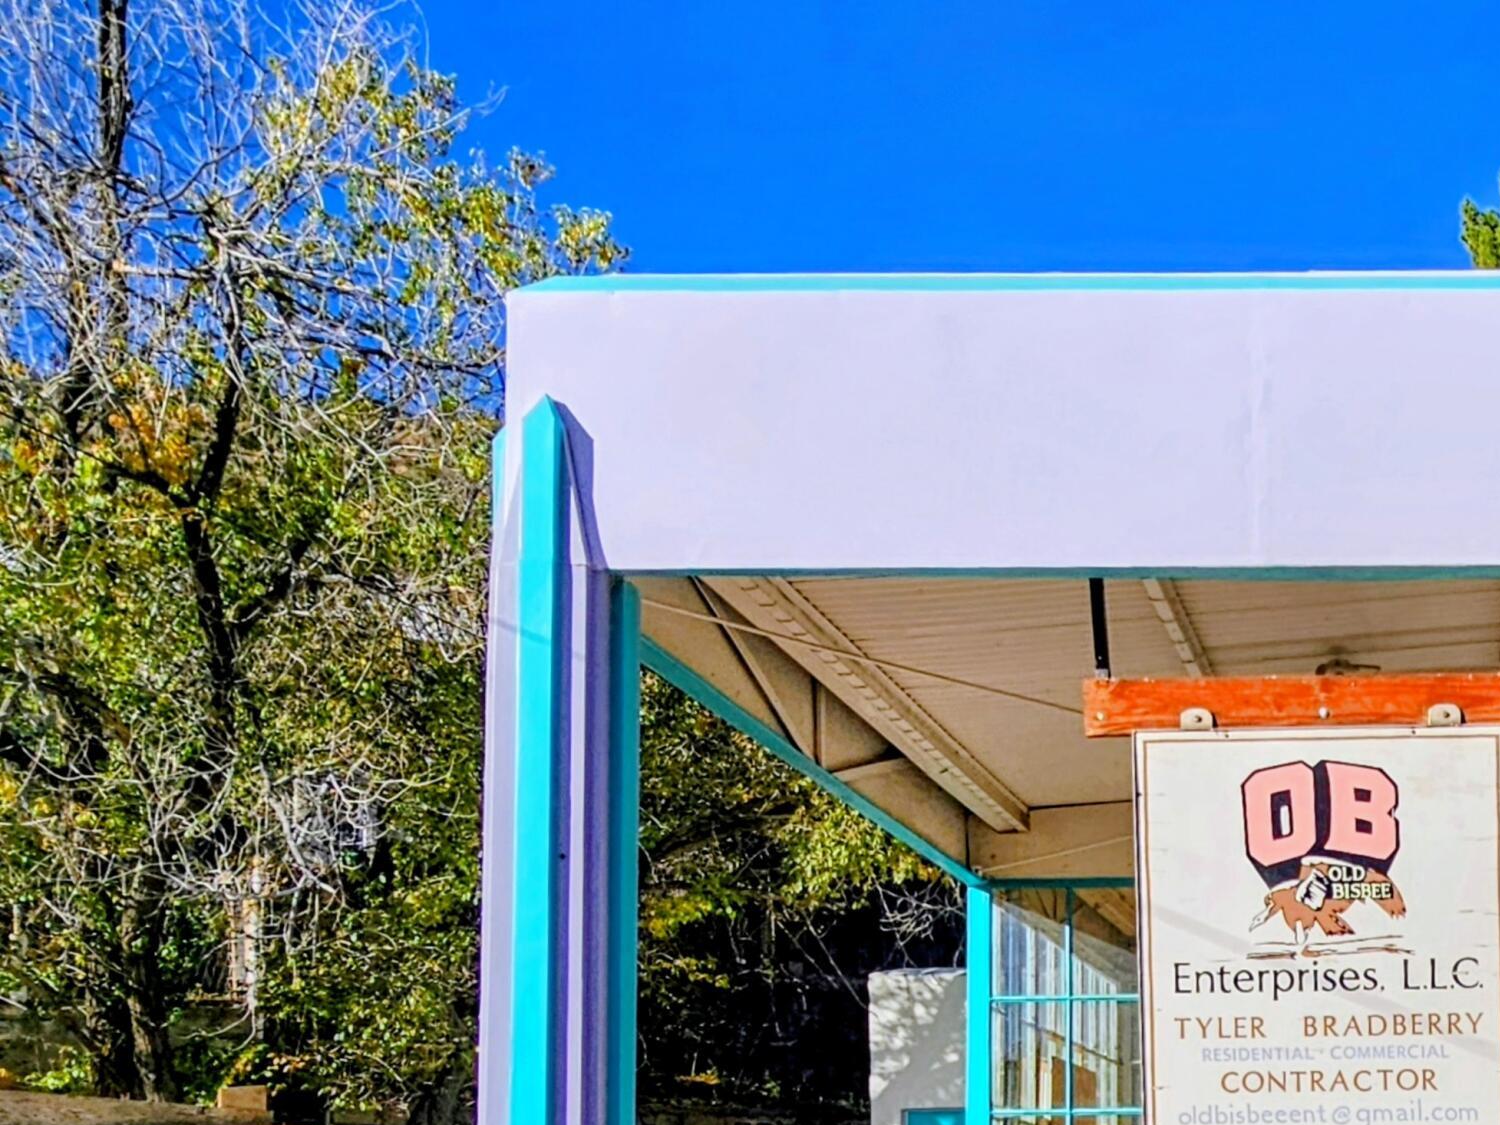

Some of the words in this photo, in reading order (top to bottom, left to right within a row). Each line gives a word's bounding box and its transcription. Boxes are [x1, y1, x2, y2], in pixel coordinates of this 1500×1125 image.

[1241, 760, 1400, 882] OB
[1328, 865, 1366, 882] OLD
[1332, 882, 1393, 899] BISBEE
[1402, 956, 1484, 990] L.L.C.
[1173, 1016, 1268, 1040] TYLER
[1302, 1011, 1484, 1038] BRADBERRY
[1201, 1046, 1315, 1063] RESIDENTIAL
[1329, 1043, 1450, 1060] COMMERCIAL
[1220, 1068, 1439, 1094] CONTRACTOR
